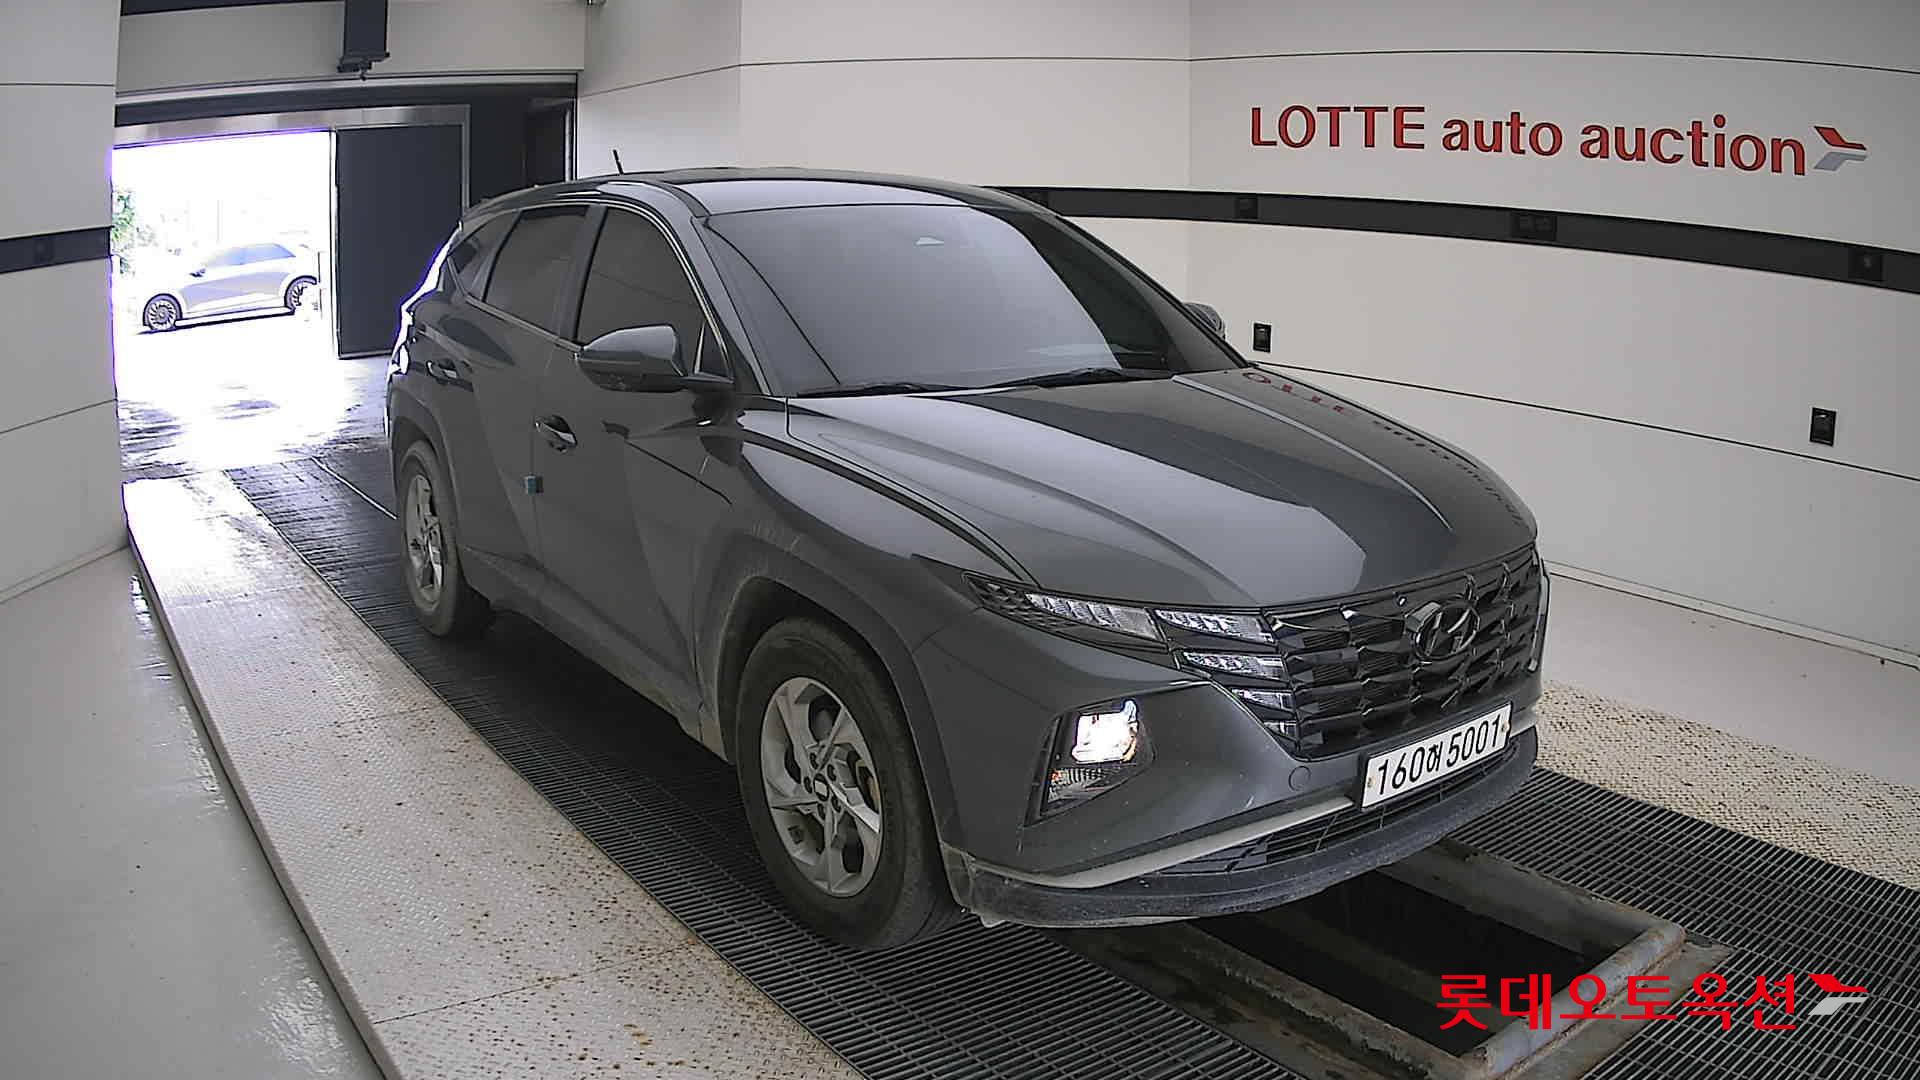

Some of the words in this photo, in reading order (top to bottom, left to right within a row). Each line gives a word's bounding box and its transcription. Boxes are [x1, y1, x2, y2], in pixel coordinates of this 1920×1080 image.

[1251, 105, 1426, 149] LOTTE
[1442, 111, 1563, 156] auto
[1580, 113, 1806, 176] auction
[1446, 714, 1501, 767] 5001
